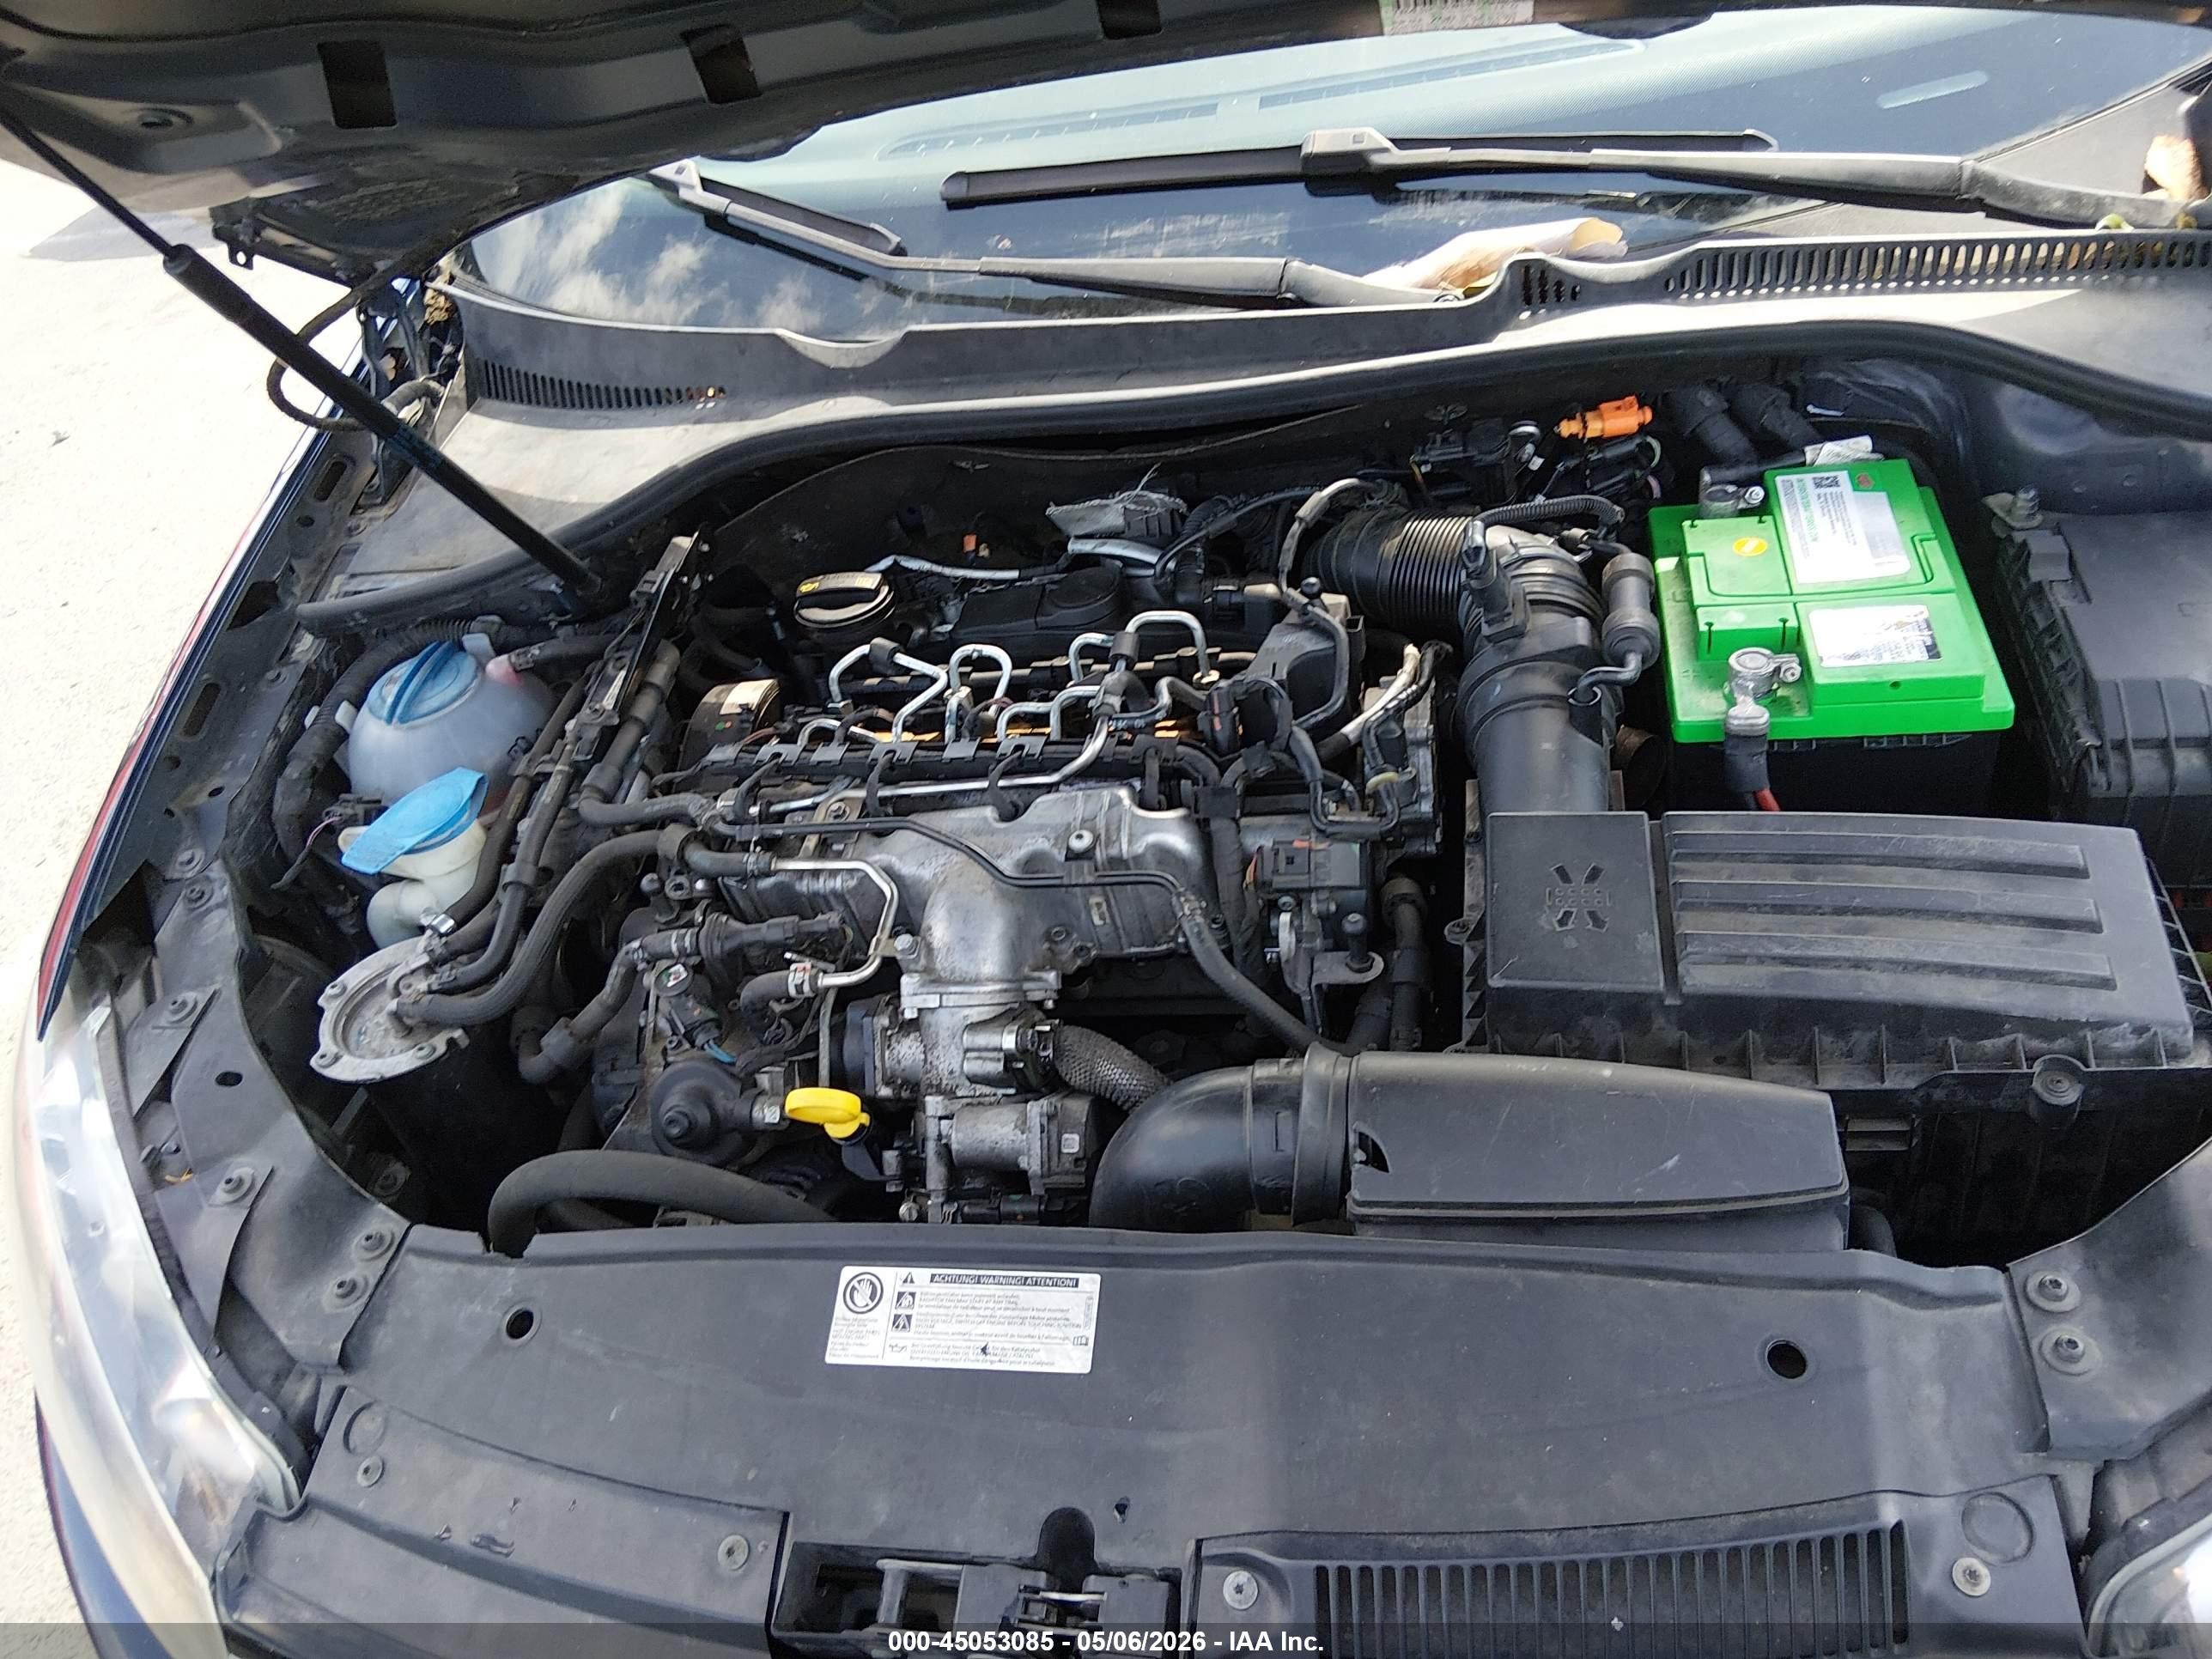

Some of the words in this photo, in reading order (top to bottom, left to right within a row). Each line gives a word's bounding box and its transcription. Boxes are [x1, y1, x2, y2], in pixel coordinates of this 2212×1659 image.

[933, 1273, 977, 1284] ACHTUNG!
[980, 1275, 1024, 1286] WARNING!
[1025, 1277, 1077, 1288] ATTENTION!
